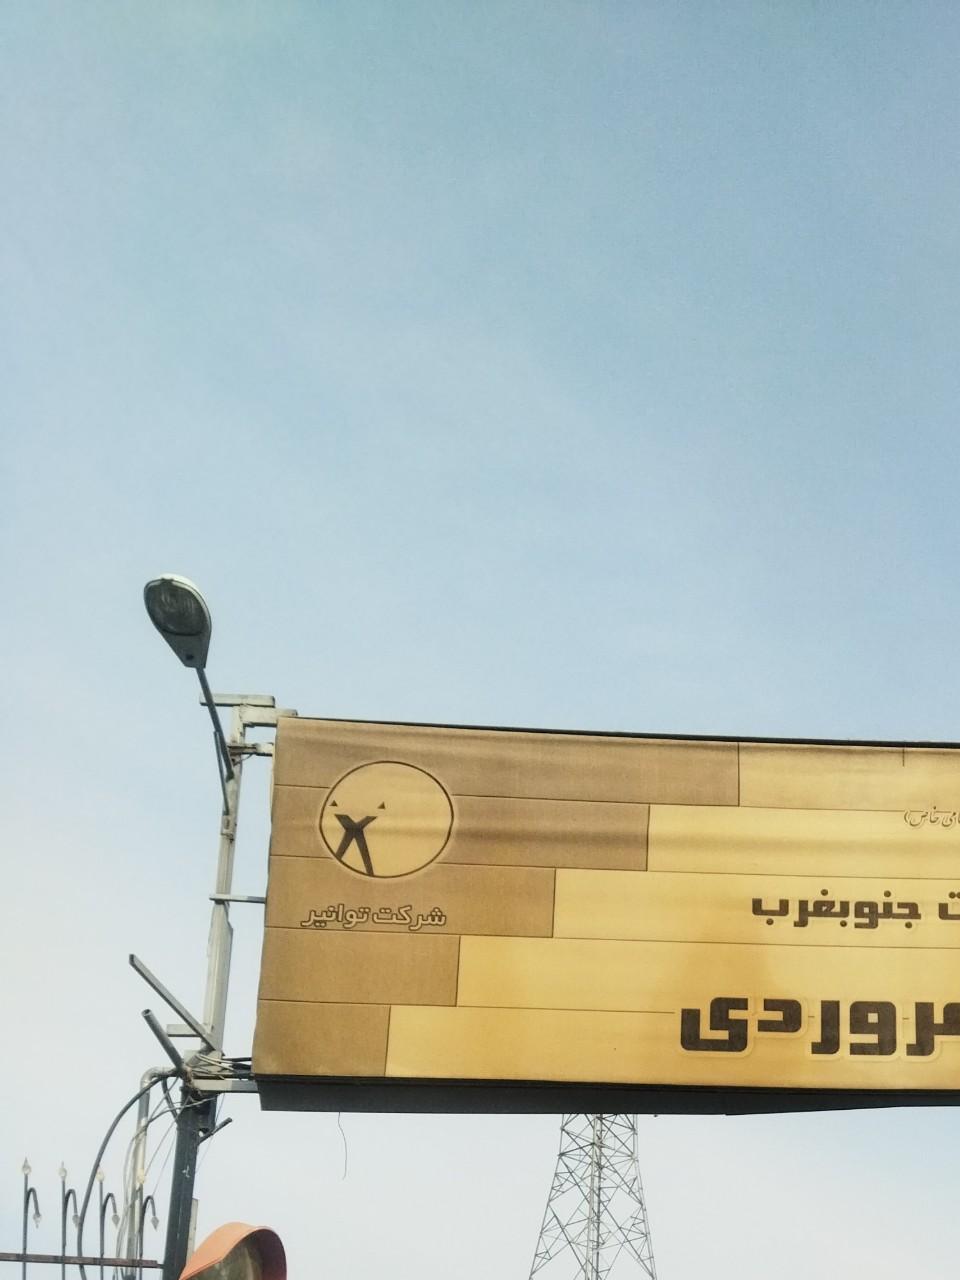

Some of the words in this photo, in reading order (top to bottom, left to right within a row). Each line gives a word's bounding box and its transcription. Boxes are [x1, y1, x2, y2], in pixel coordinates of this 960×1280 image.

[300, 903, 371, 928] توانیر
[372, 904, 447, 931] شرکت
[751, 888, 922, 929] جنوبغرب
